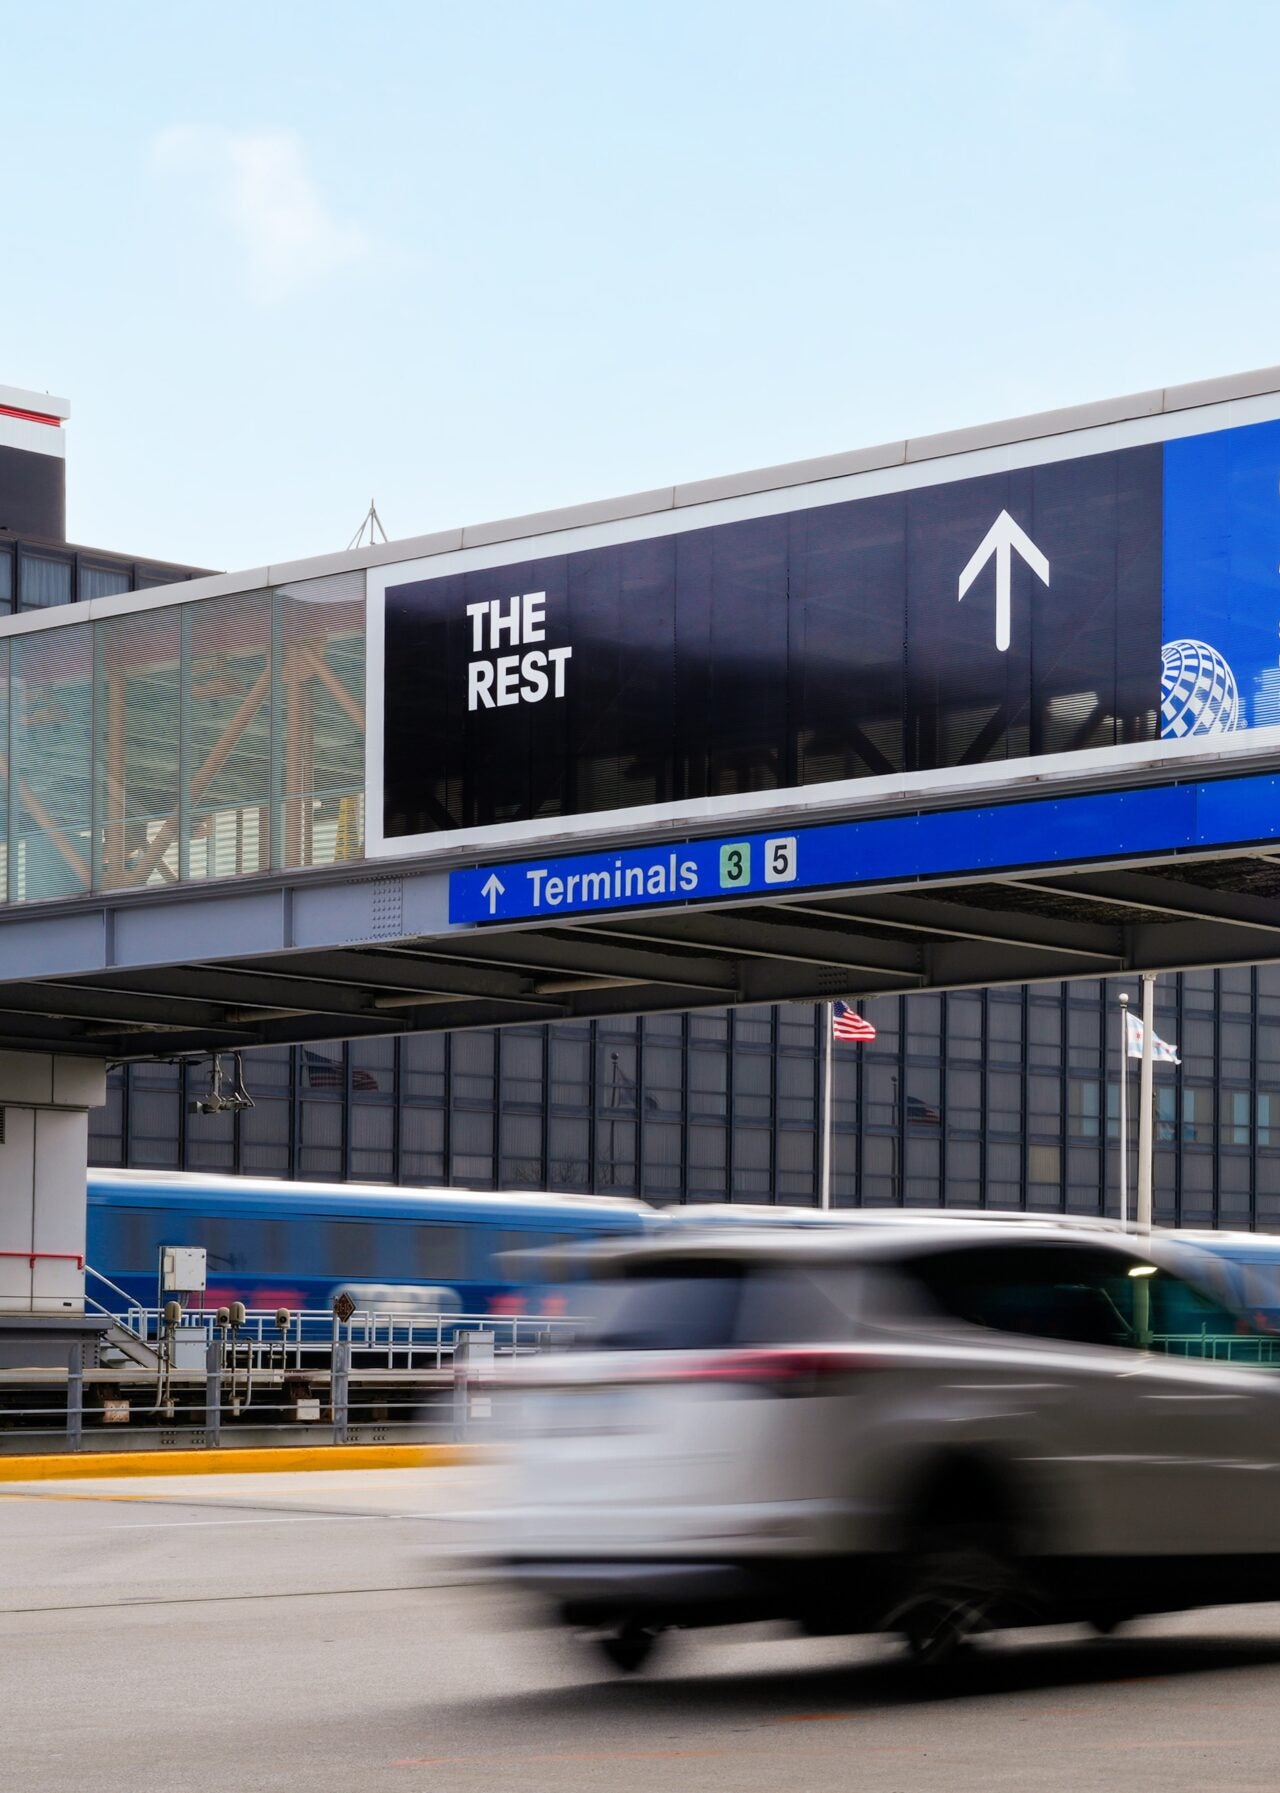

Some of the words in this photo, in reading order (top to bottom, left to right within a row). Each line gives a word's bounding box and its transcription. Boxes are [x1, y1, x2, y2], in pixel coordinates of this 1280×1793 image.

[466, 591, 546, 652] THE
[468, 646, 572, 712] REST
[527, 855, 698, 907] Terminals
[727, 850, 743, 882] 3
[772, 844, 788, 876] 5
